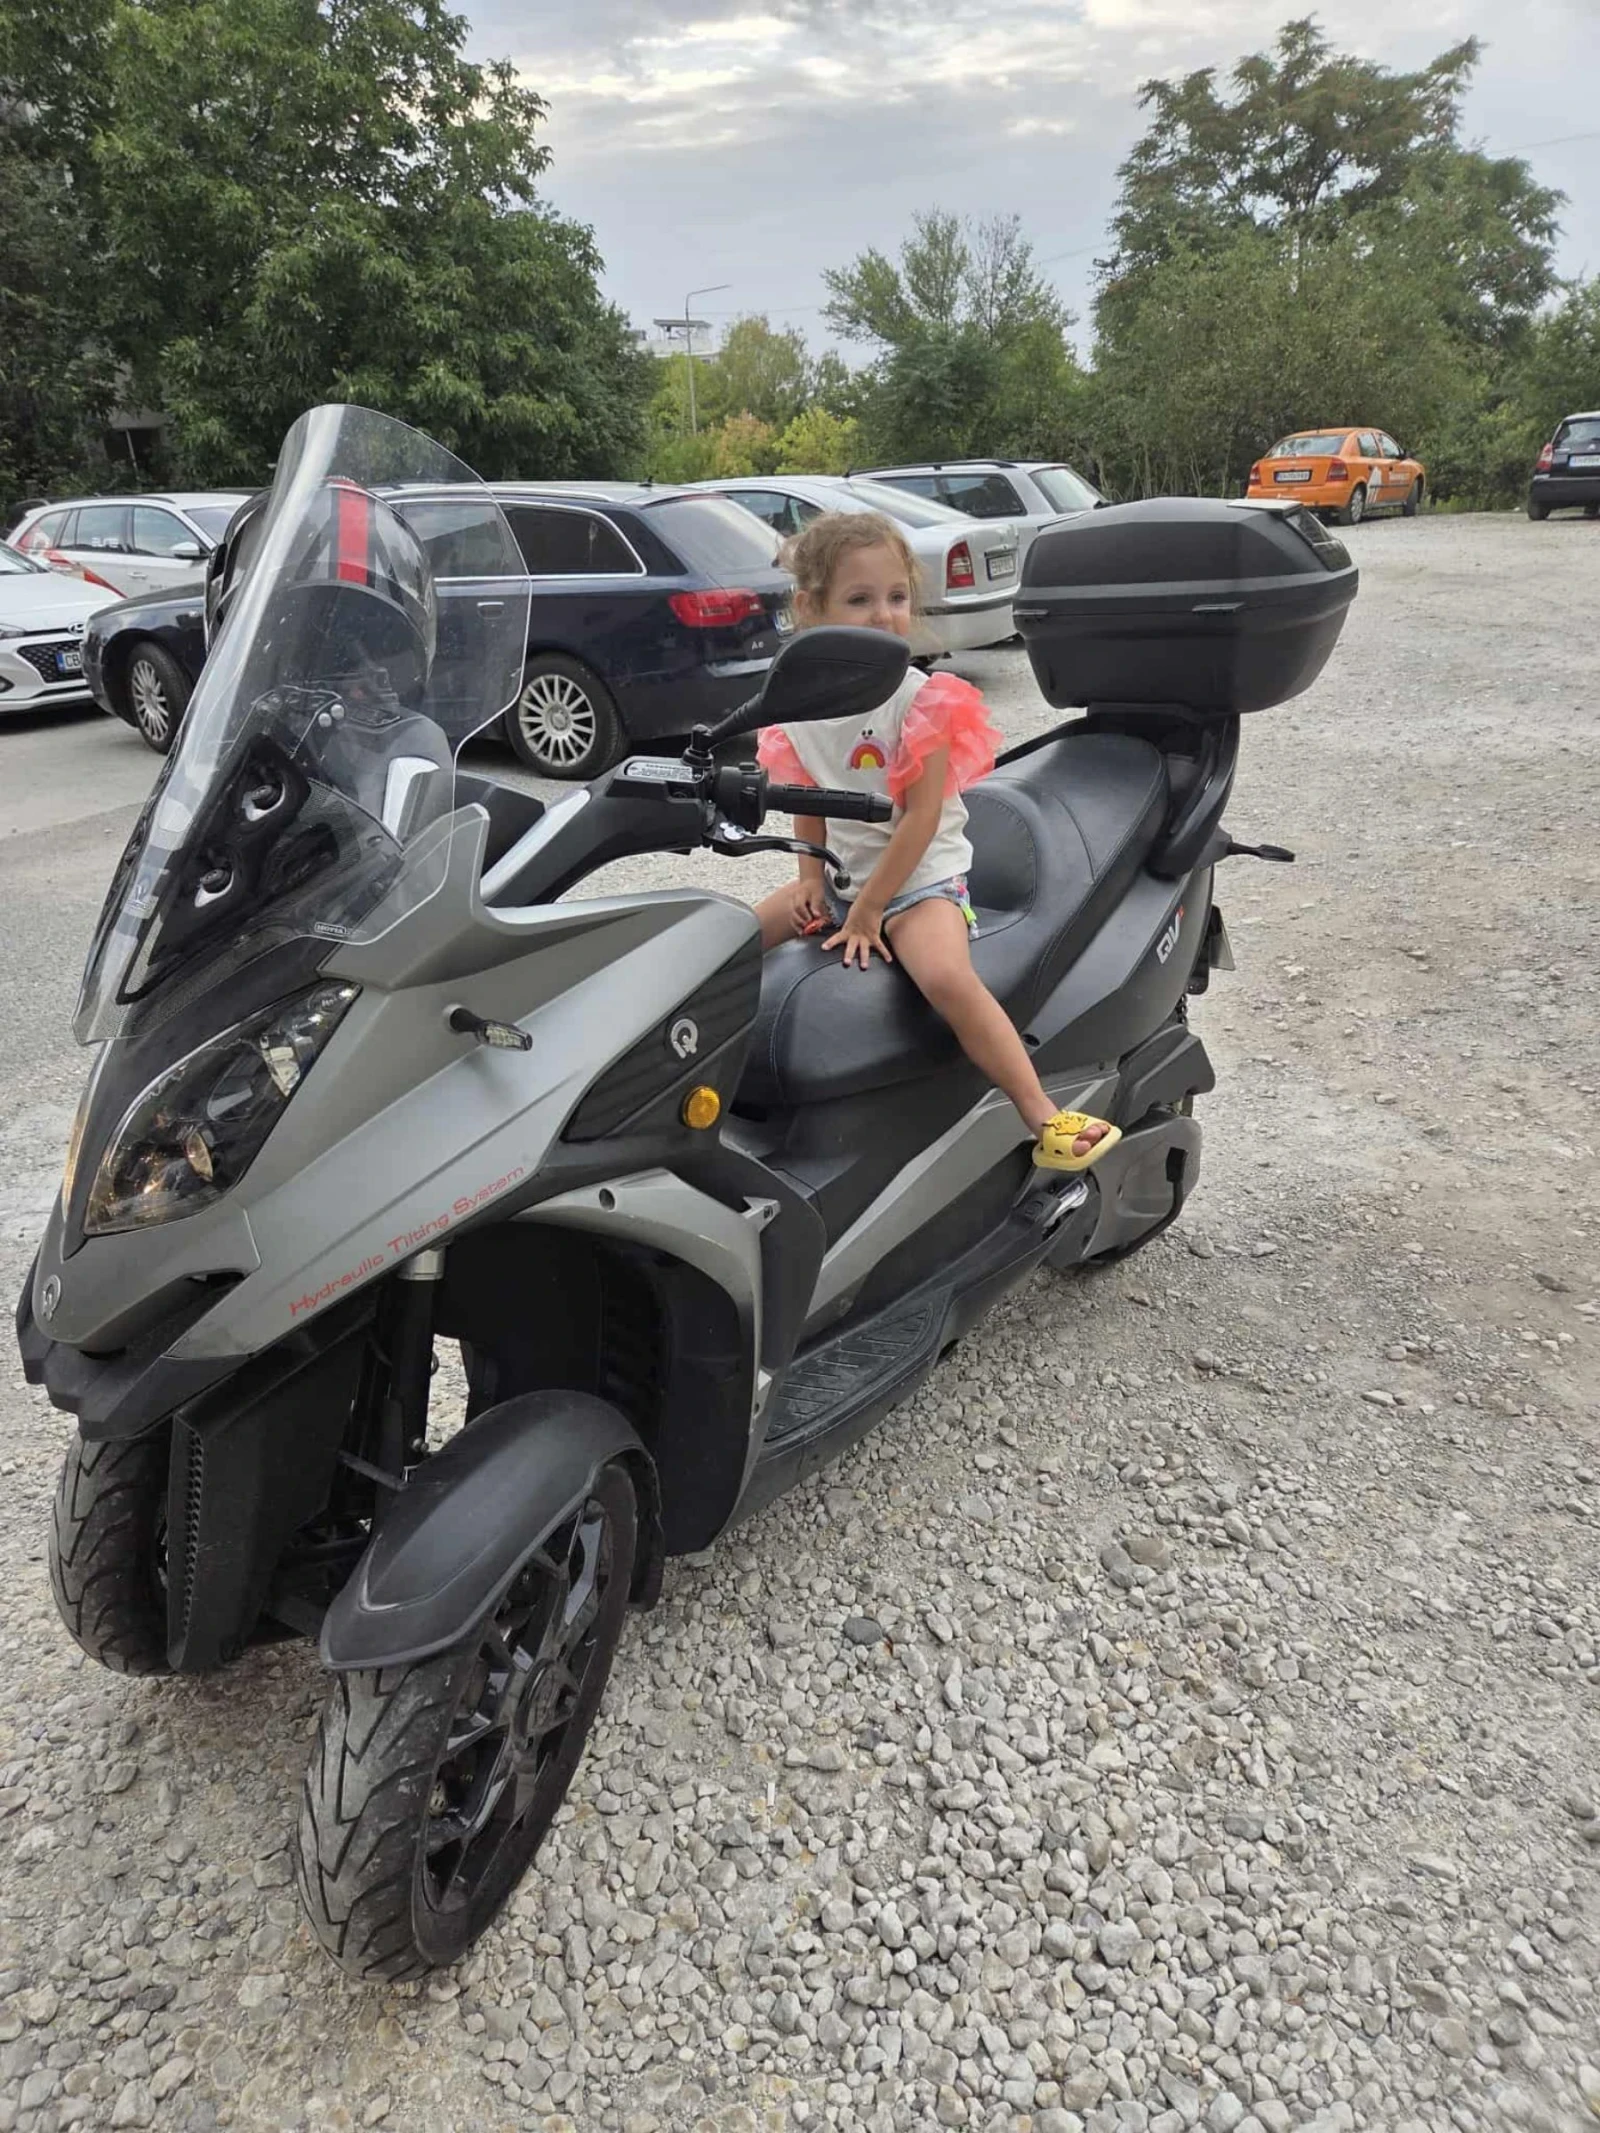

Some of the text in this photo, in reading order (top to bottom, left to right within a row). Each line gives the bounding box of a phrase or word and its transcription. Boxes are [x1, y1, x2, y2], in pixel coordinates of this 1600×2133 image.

[289, 1166, 524, 1316] Hydraulic Tilting System
